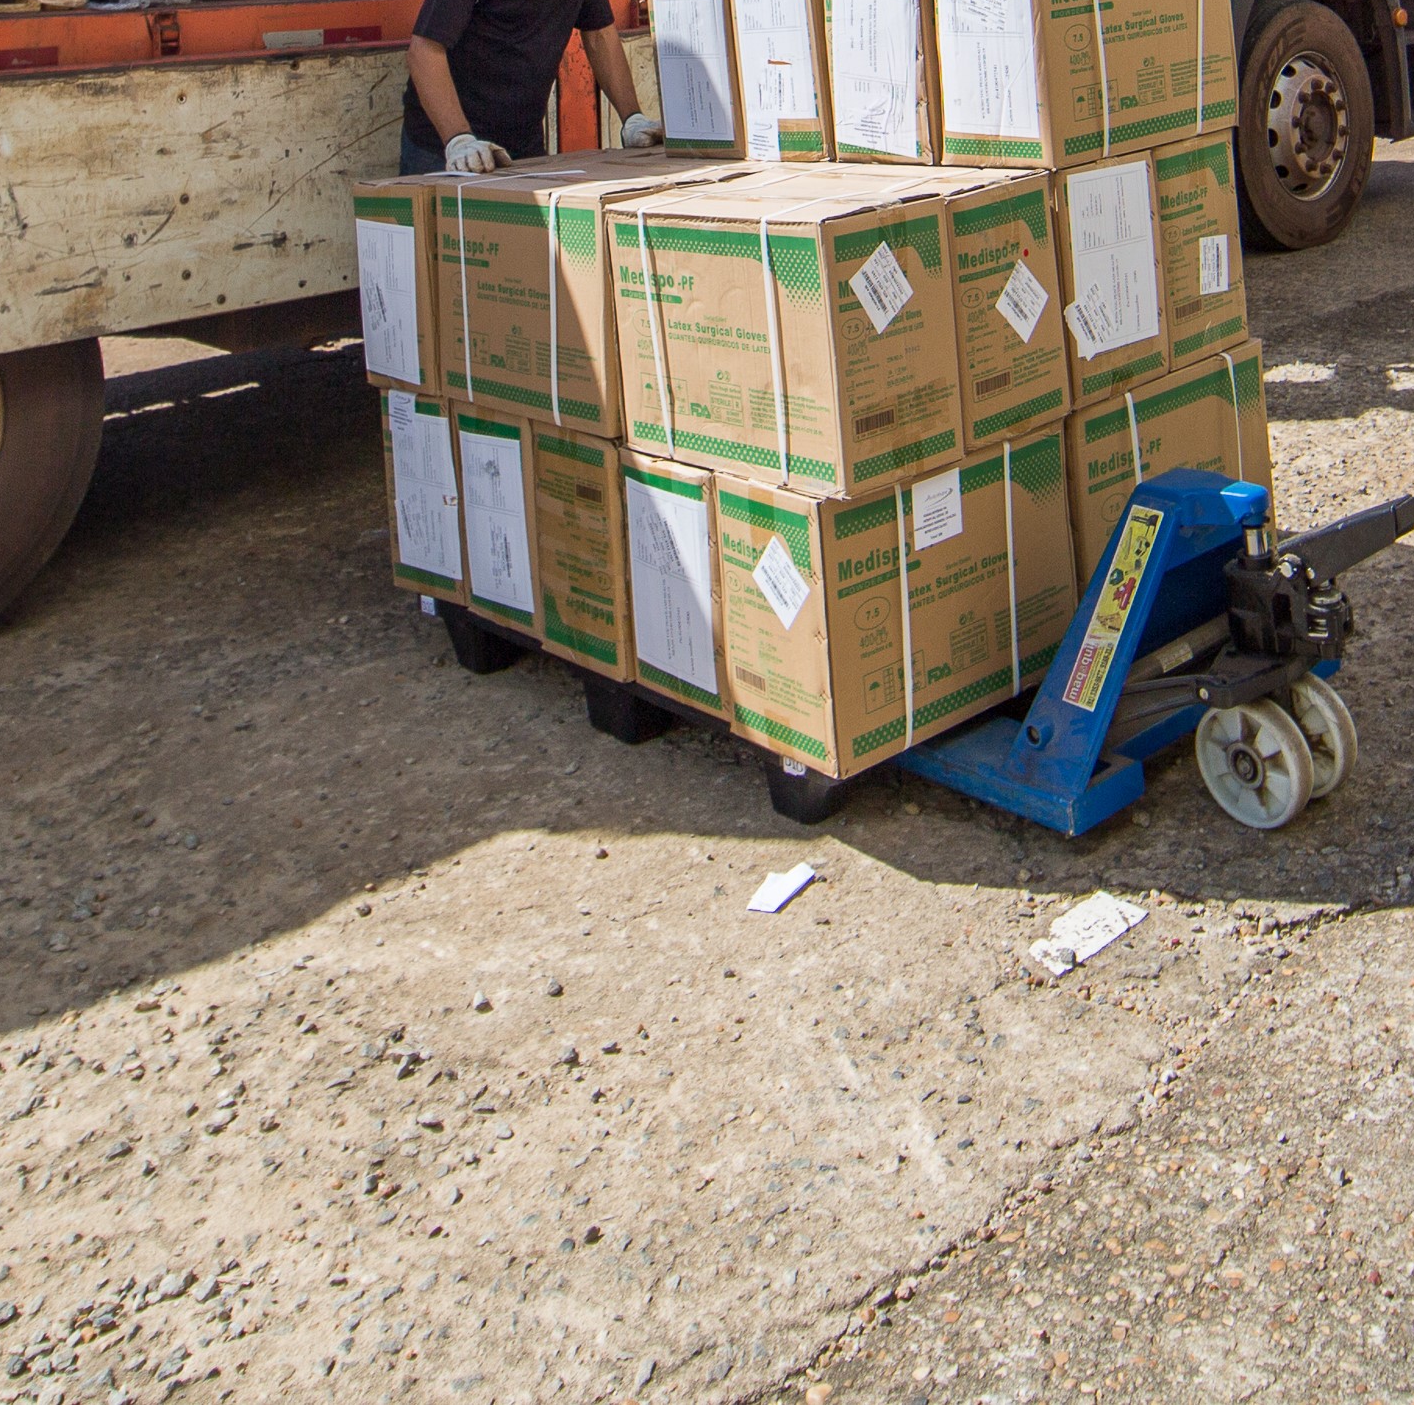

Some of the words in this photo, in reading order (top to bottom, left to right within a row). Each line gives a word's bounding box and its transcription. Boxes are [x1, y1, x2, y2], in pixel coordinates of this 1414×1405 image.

[1101, 24, 1123, 35] Latex
[1124, 15, 1157, 32] Surgical
[1159, 13, 1184, 25] Gloves
[677, 275, 695, 291] -PF
[966, 293, 979, 303] 7.5
[668, 319, 693, 332] Latex
[695, 322, 733, 339] Surgical
[736, 327, 768, 343] Gloves
[847, 323, 860, 335] 7.5
[690, 403, 712, 419] FDA
[1146, 437, 1162, 456] -PF
[908, 581, 932, 601] atex
[936, 561, 978, 591] Surgical
[980, 551, 1008, 569] Glove
[865, 607, 880, 621] 7.5
[926, 662, 952, 685] FDA
